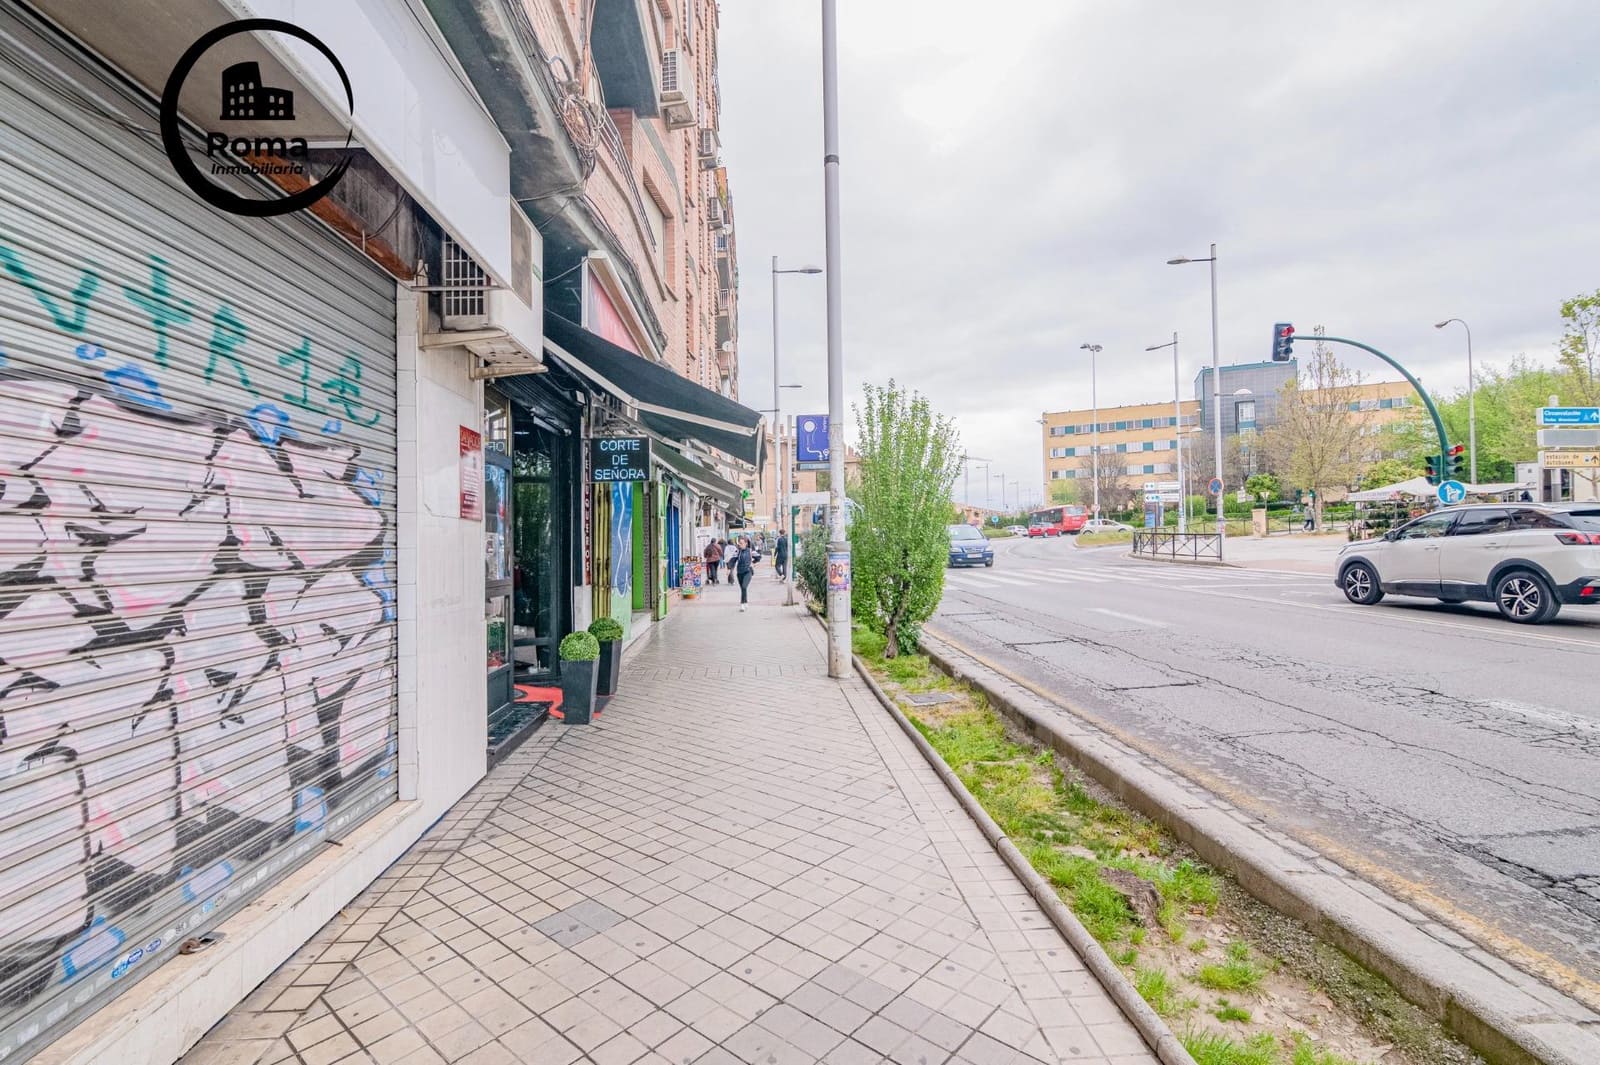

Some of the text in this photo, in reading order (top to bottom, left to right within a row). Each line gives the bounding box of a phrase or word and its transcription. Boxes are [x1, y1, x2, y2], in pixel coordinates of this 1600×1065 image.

[600, 440, 640, 451] CORTE
[612, 454, 629, 465] DE
[594, 466, 646, 480] SEÑORA
